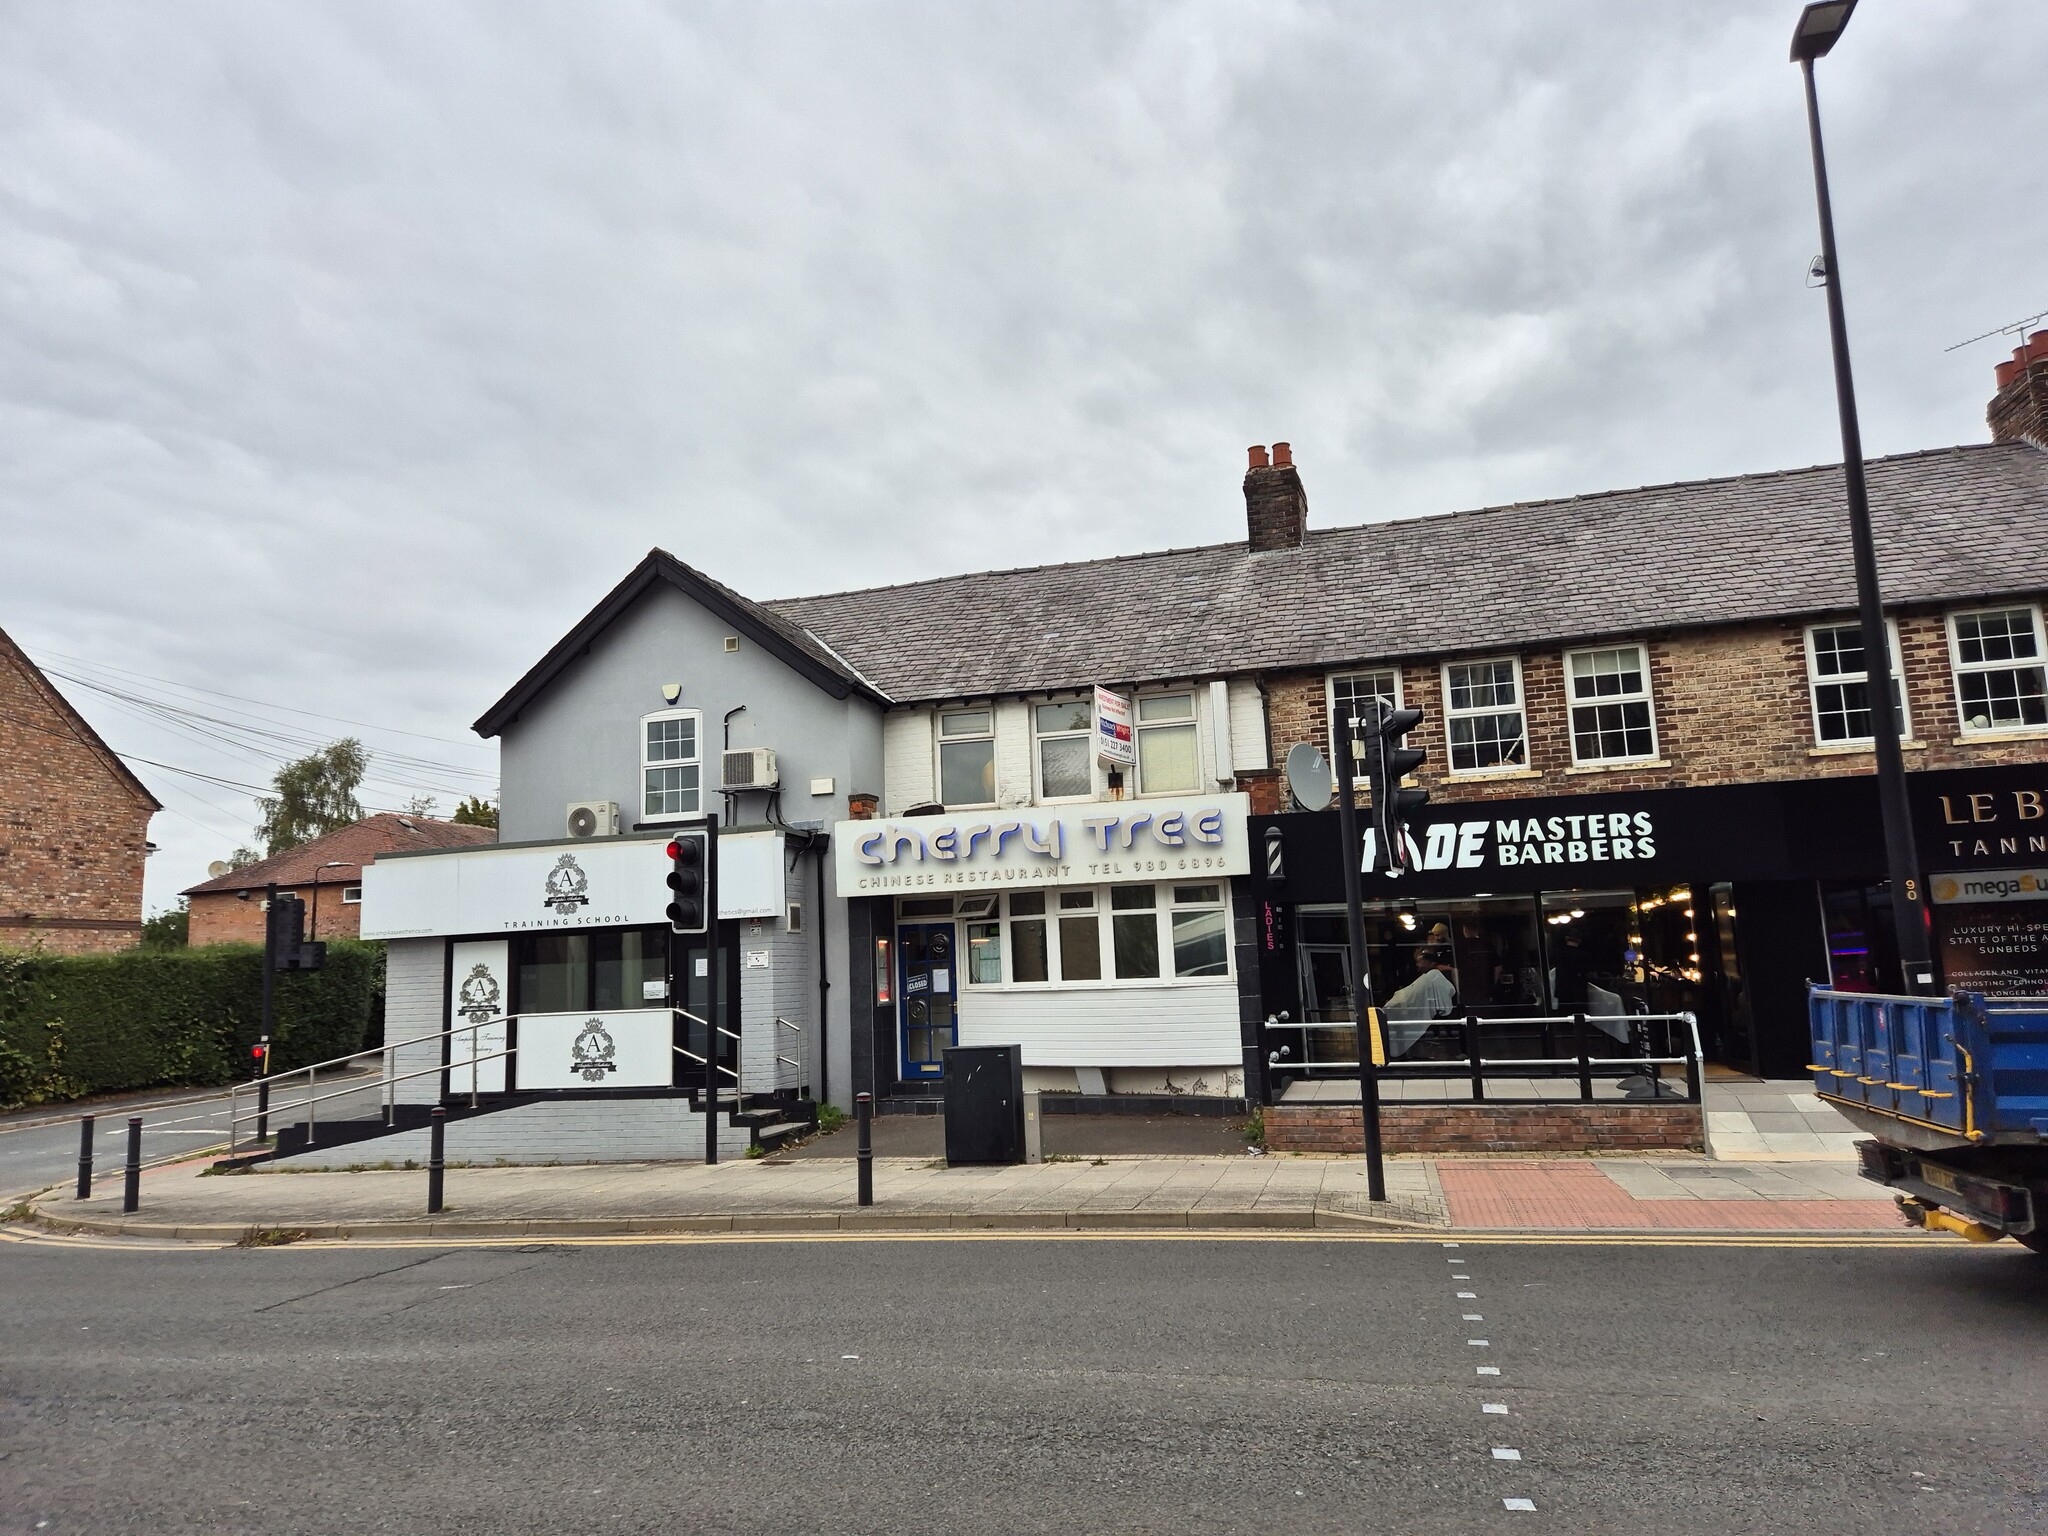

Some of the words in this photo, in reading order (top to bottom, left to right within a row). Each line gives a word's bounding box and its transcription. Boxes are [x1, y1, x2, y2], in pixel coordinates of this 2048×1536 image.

[1938, 793, 1997, 825] LE
[2011, 789, 2048, 820] B
[1495, 811, 1653, 843] MASTERS
[1498, 837, 1657, 866] BARBERS
[559, 869, 574, 888] A
[857, 873, 935, 889] CHINESE
[943, 865, 1071, 883] RESTAURANT
[1088, 863, 1122, 875] TEL
[1133, 860, 1168, 872] 980
[1178, 856, 1226, 870] 6896
[504, 918, 569, 929] TRAINING
[577, 914, 629, 925] SCHOOL
[1264, 901, 1275, 950] LADIES
[1953, 925, 2002, 935] LUXURY
[1949, 936, 1987, 945] STATE
[1992, 935, 2008, 943] OF
[2012, 934, 2037, 943] THE
[1979, 945, 2038, 954] SUNBEDS
[472, 978, 487, 997] A
[908, 979, 928, 990] CLOSED
[586, 1034, 601, 1053] A
